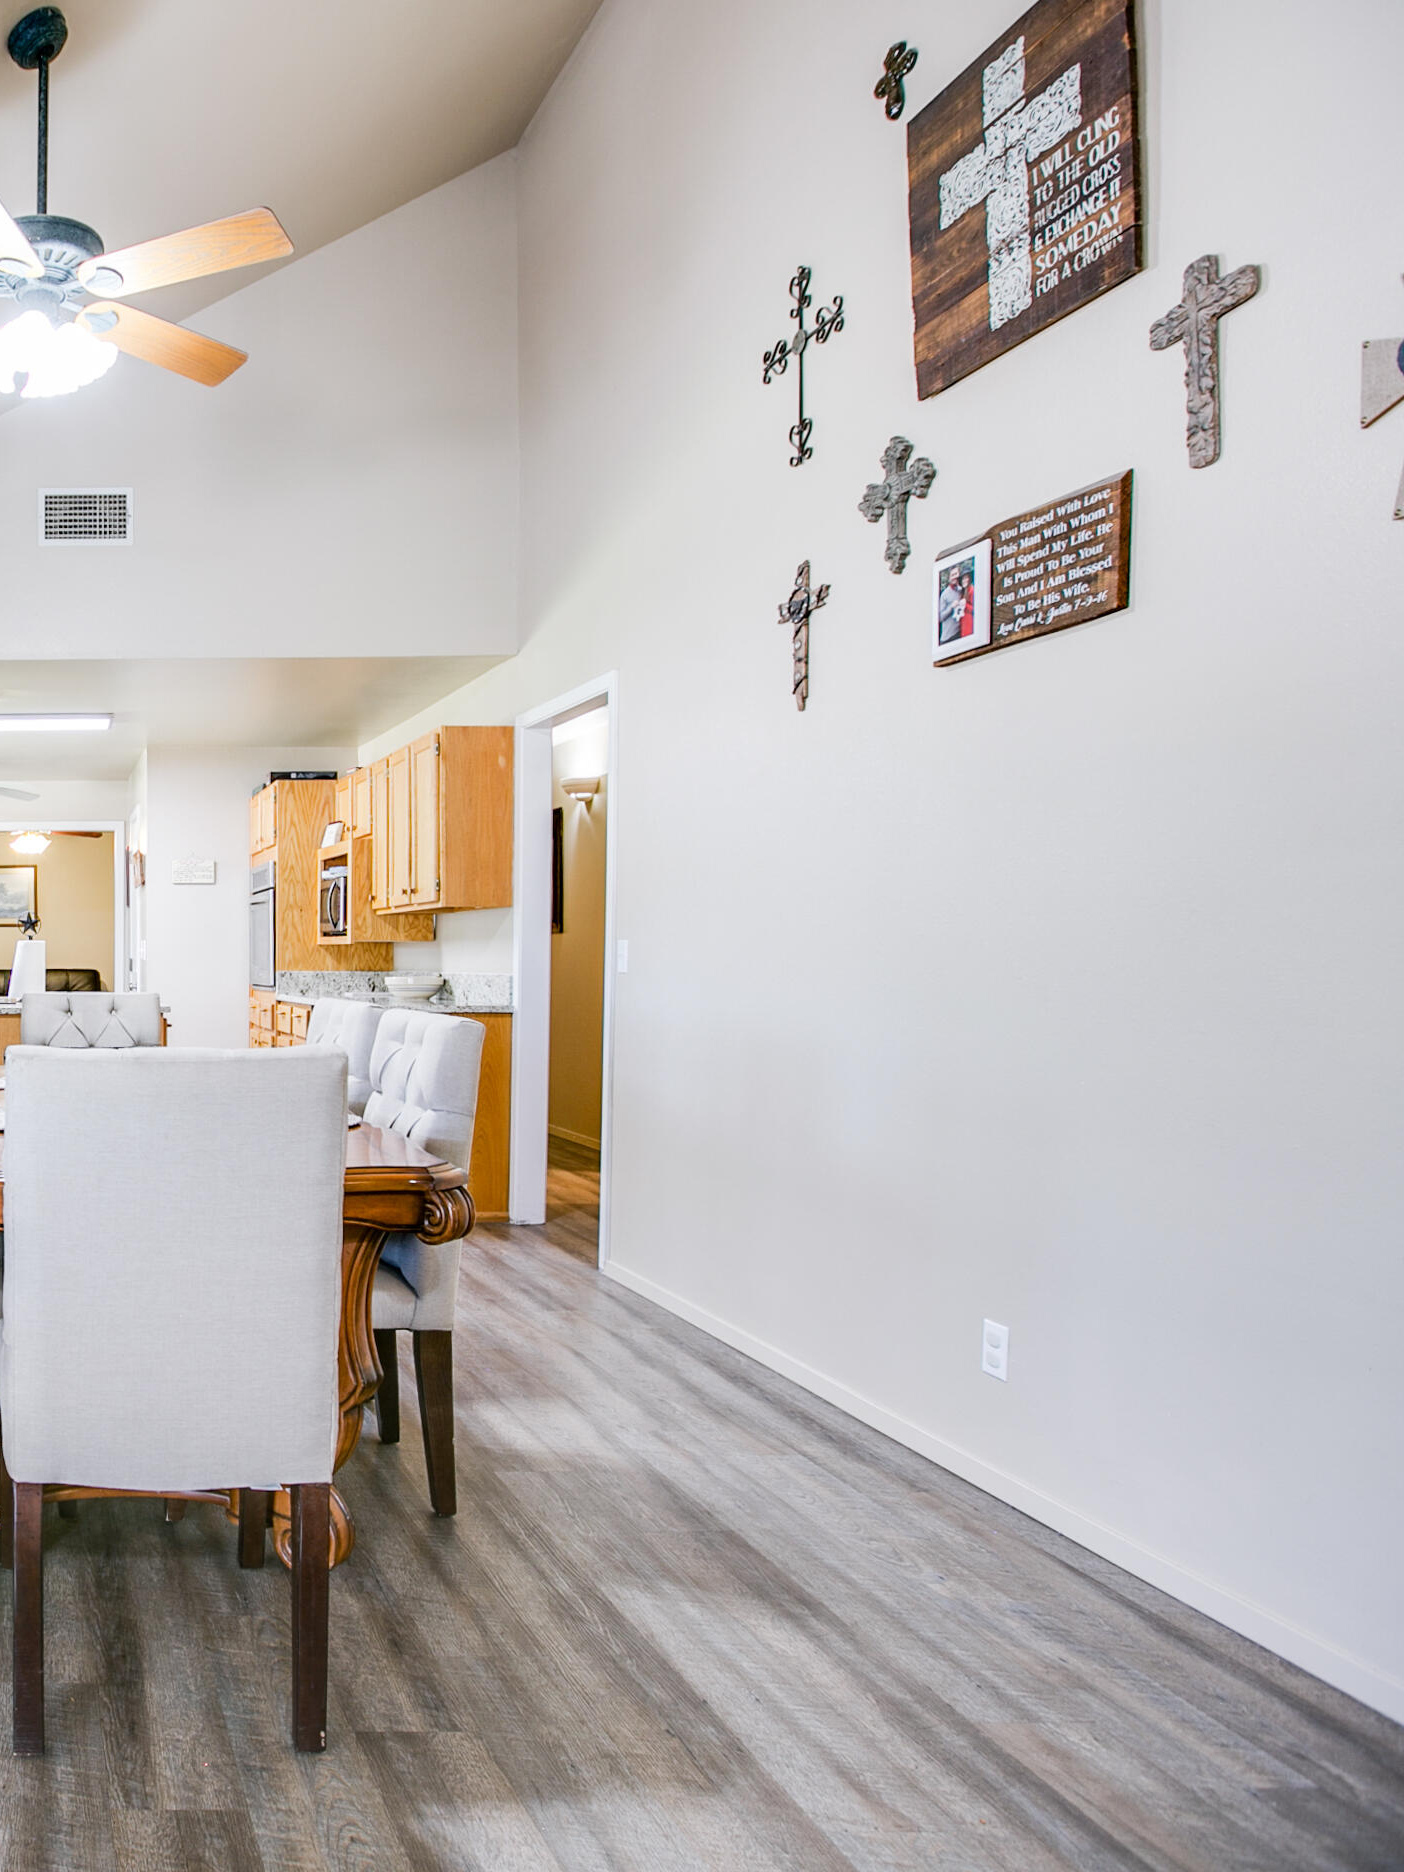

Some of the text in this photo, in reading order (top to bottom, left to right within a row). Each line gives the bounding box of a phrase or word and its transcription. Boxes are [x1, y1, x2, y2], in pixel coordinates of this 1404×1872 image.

[1032, 106, 1120, 186] I WILL CLING
[1034, 130, 1121, 206] TO THE OLD
[1034, 153, 1122, 231] RUGGED CROSS
[1044, 186, 1109, 246] EXCHANGE
[1109, 175, 1122, 201] IT
[1035, 201, 1123, 275] SOMEDAY
[1035, 224, 1124, 297] FOR A CROWN
[996, 502, 1114, 558] This Man With Whom I
[999, 488, 1112, 541] You Raised With Love
[996, 557, 1016, 574] Will
[1017, 544, 1050, 567] Spend
[1051, 539, 1068, 554] My
[1096, 522, 1114, 536] He
[1003, 543, 1105, 588] Is Proud To Be Your
[995, 591, 1015, 606] Son
[1017, 581, 1038, 599] And
[1047, 574, 1066, 588] Am
[1067, 555, 1113, 581] Blessed
[1013, 604, 1026, 616] To
[1026, 599, 1041, 611] Be
[1042, 592, 1061, 606] His
